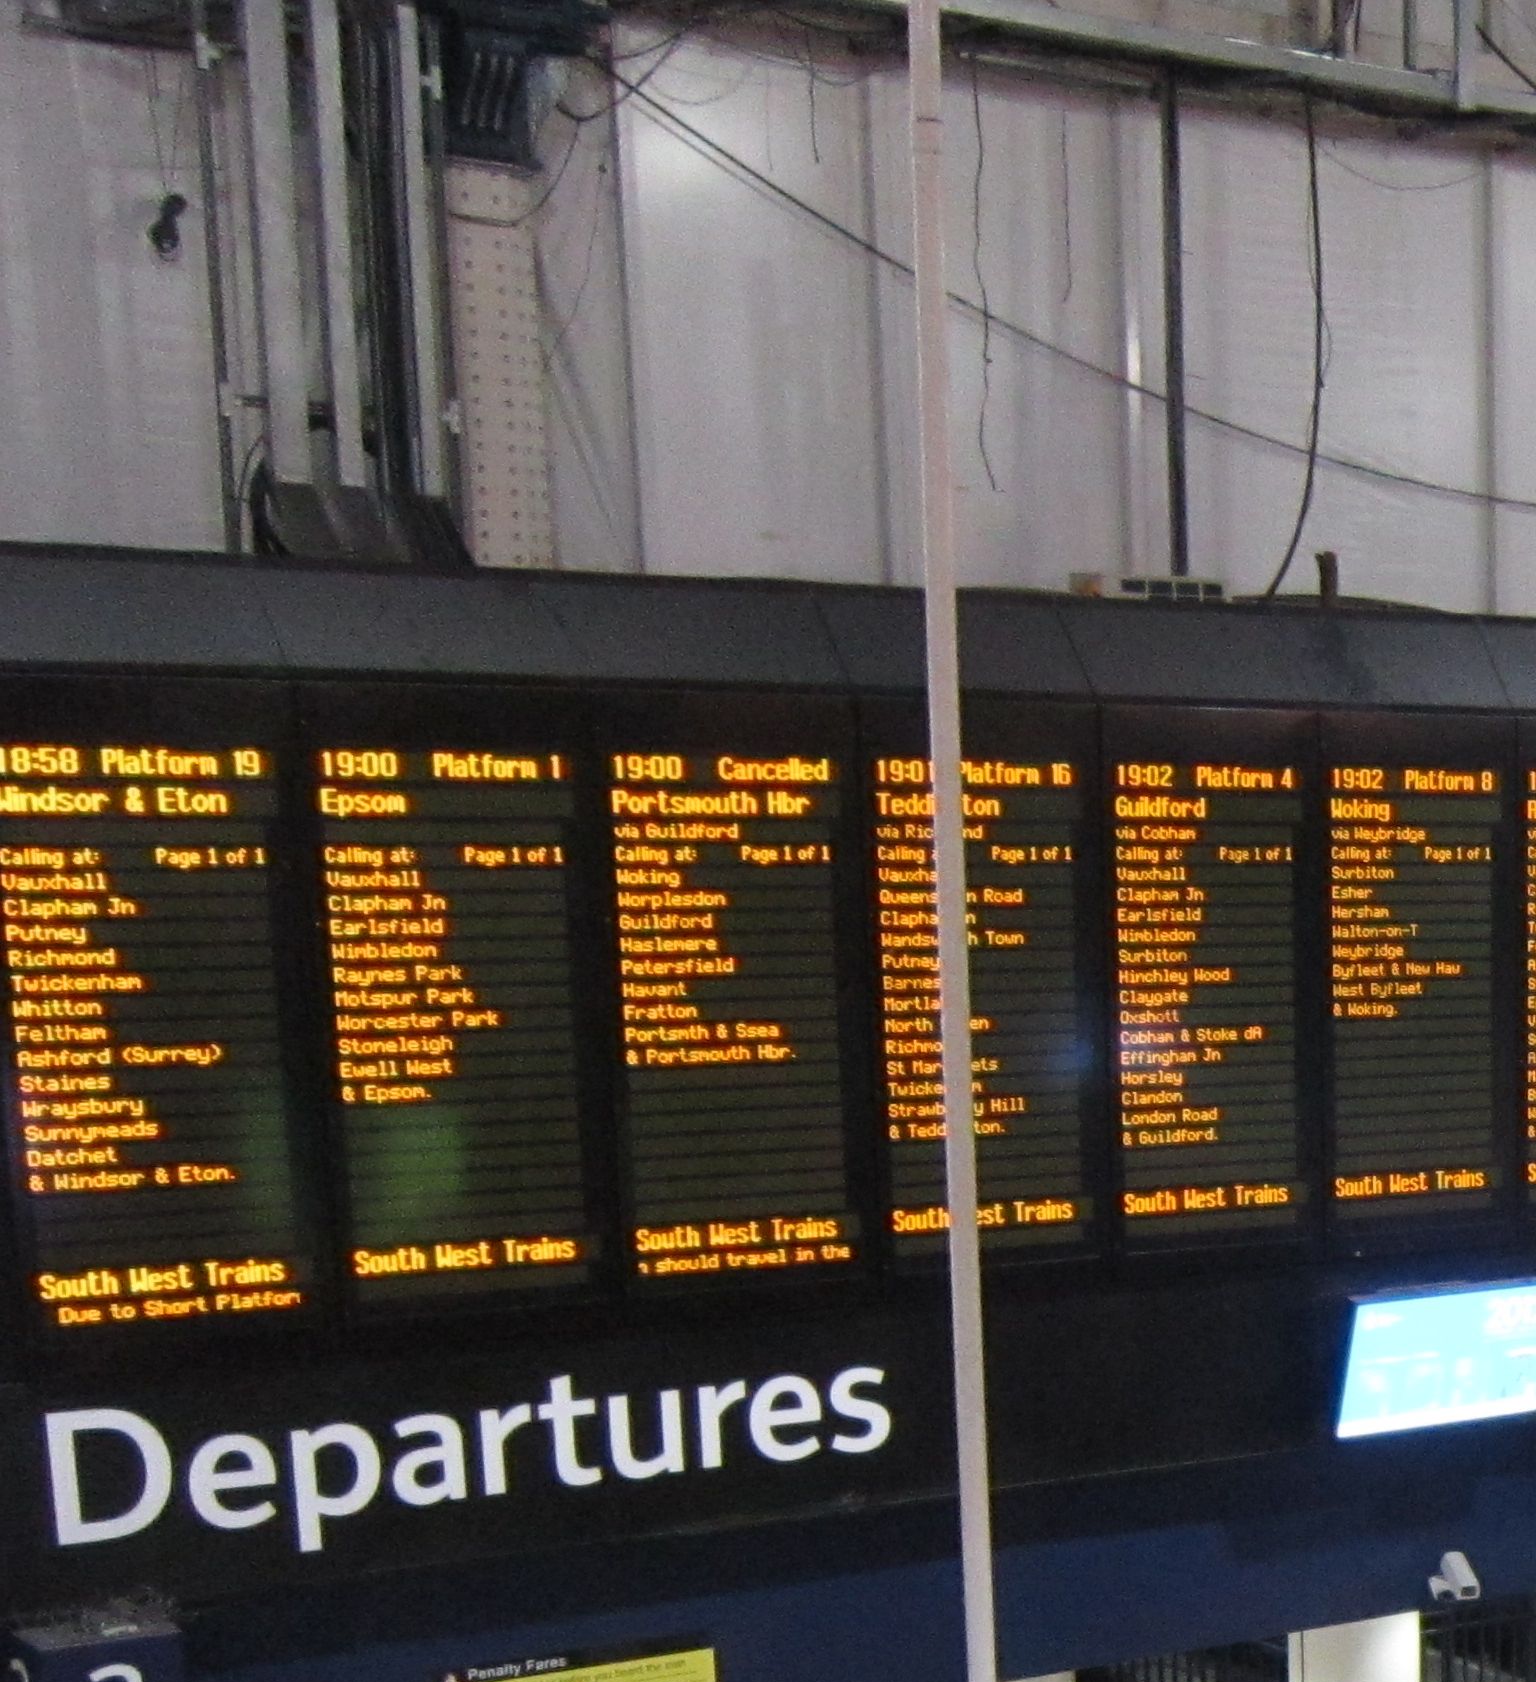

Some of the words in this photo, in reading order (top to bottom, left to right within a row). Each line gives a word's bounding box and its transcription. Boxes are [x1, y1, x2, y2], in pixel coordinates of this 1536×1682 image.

[101, 749, 218, 775] Platform
[234, 751, 260, 775] 19
[323, 752, 397, 776] 19:00
[433, 753, 537, 779] Platform
[551, 755, 560, 778] 1
[614, 756, 683, 779] 19:00
[718, 757, 828, 782] Cancelled
[1052, 764, 1071, 784] 16
[1119, 765, 1172, 786] 19:02
[1197, 766, 1273, 788] Platform
[1281, 769, 1292, 788] 4
[1334, 769, 1383, 789] 19:02
[1405, 770, 1475, 790] Platform
[1482, 772, 1492, 790] 8
[125, 787, 144, 812] &
[157, 787, 227, 813] Eton
[321, 788, 406, 816] Epsom
[612, 790, 758, 814] Portsmouth
[768, 791, 810, 814] Hbr
[1116, 796, 1205, 817] Guildford
[1331, 799, 1390, 822] Woking
[615, 824, 640, 839] via
[646, 823, 738, 839] Guildford
[1, 873, 106, 890] Vauxhall
[617, 869, 680, 888] Woking
[1332, 886, 1372, 899] Esher
[4, 899, 97, 919] Clapham
[108, 898, 135, 914] Jn
[6, 924, 86, 944] Putney
[330, 918, 443, 935] Earlsfield
[8, 949, 115, 966] Richmond
[622, 958, 734, 975] Petersfield
[1119, 949, 1187, 963] Surbiton
[12, 974, 141, 992] Twickenham
[339, 1036, 452, 1055] Stoneleigh
[20, 1075, 110, 1093] Staines
[1122, 1070, 1182, 1085] Horsley
[27, 1147, 117, 1167] Datchet
[1336, 1176, 1382, 1197] South
[1390, 1173, 1428, 1192] West
[1437, 1170, 1484, 1188] Trains
[1124, 1191, 1177, 1213] South
[1184, 1188, 1226, 1209] West
[1235, 1184, 1288, 1205] Trains
[636, 1226, 701, 1251] South
[709, 1222, 761, 1246] West
[772, 1218, 837, 1240] Trains
[354, 1247, 426, 1274] South
[436, 1242, 492, 1268] West
[503, 1237, 576, 1262] Trains
[39, 1271, 119, 1299] South
[129, 1266, 193, 1292] West
[205, 1260, 285, 1286] Trains
[45, 1366, 892, 1552] Departures
[468, 1661, 520, 1680] Penalty
[526, 1657, 566, 1670] Fares
